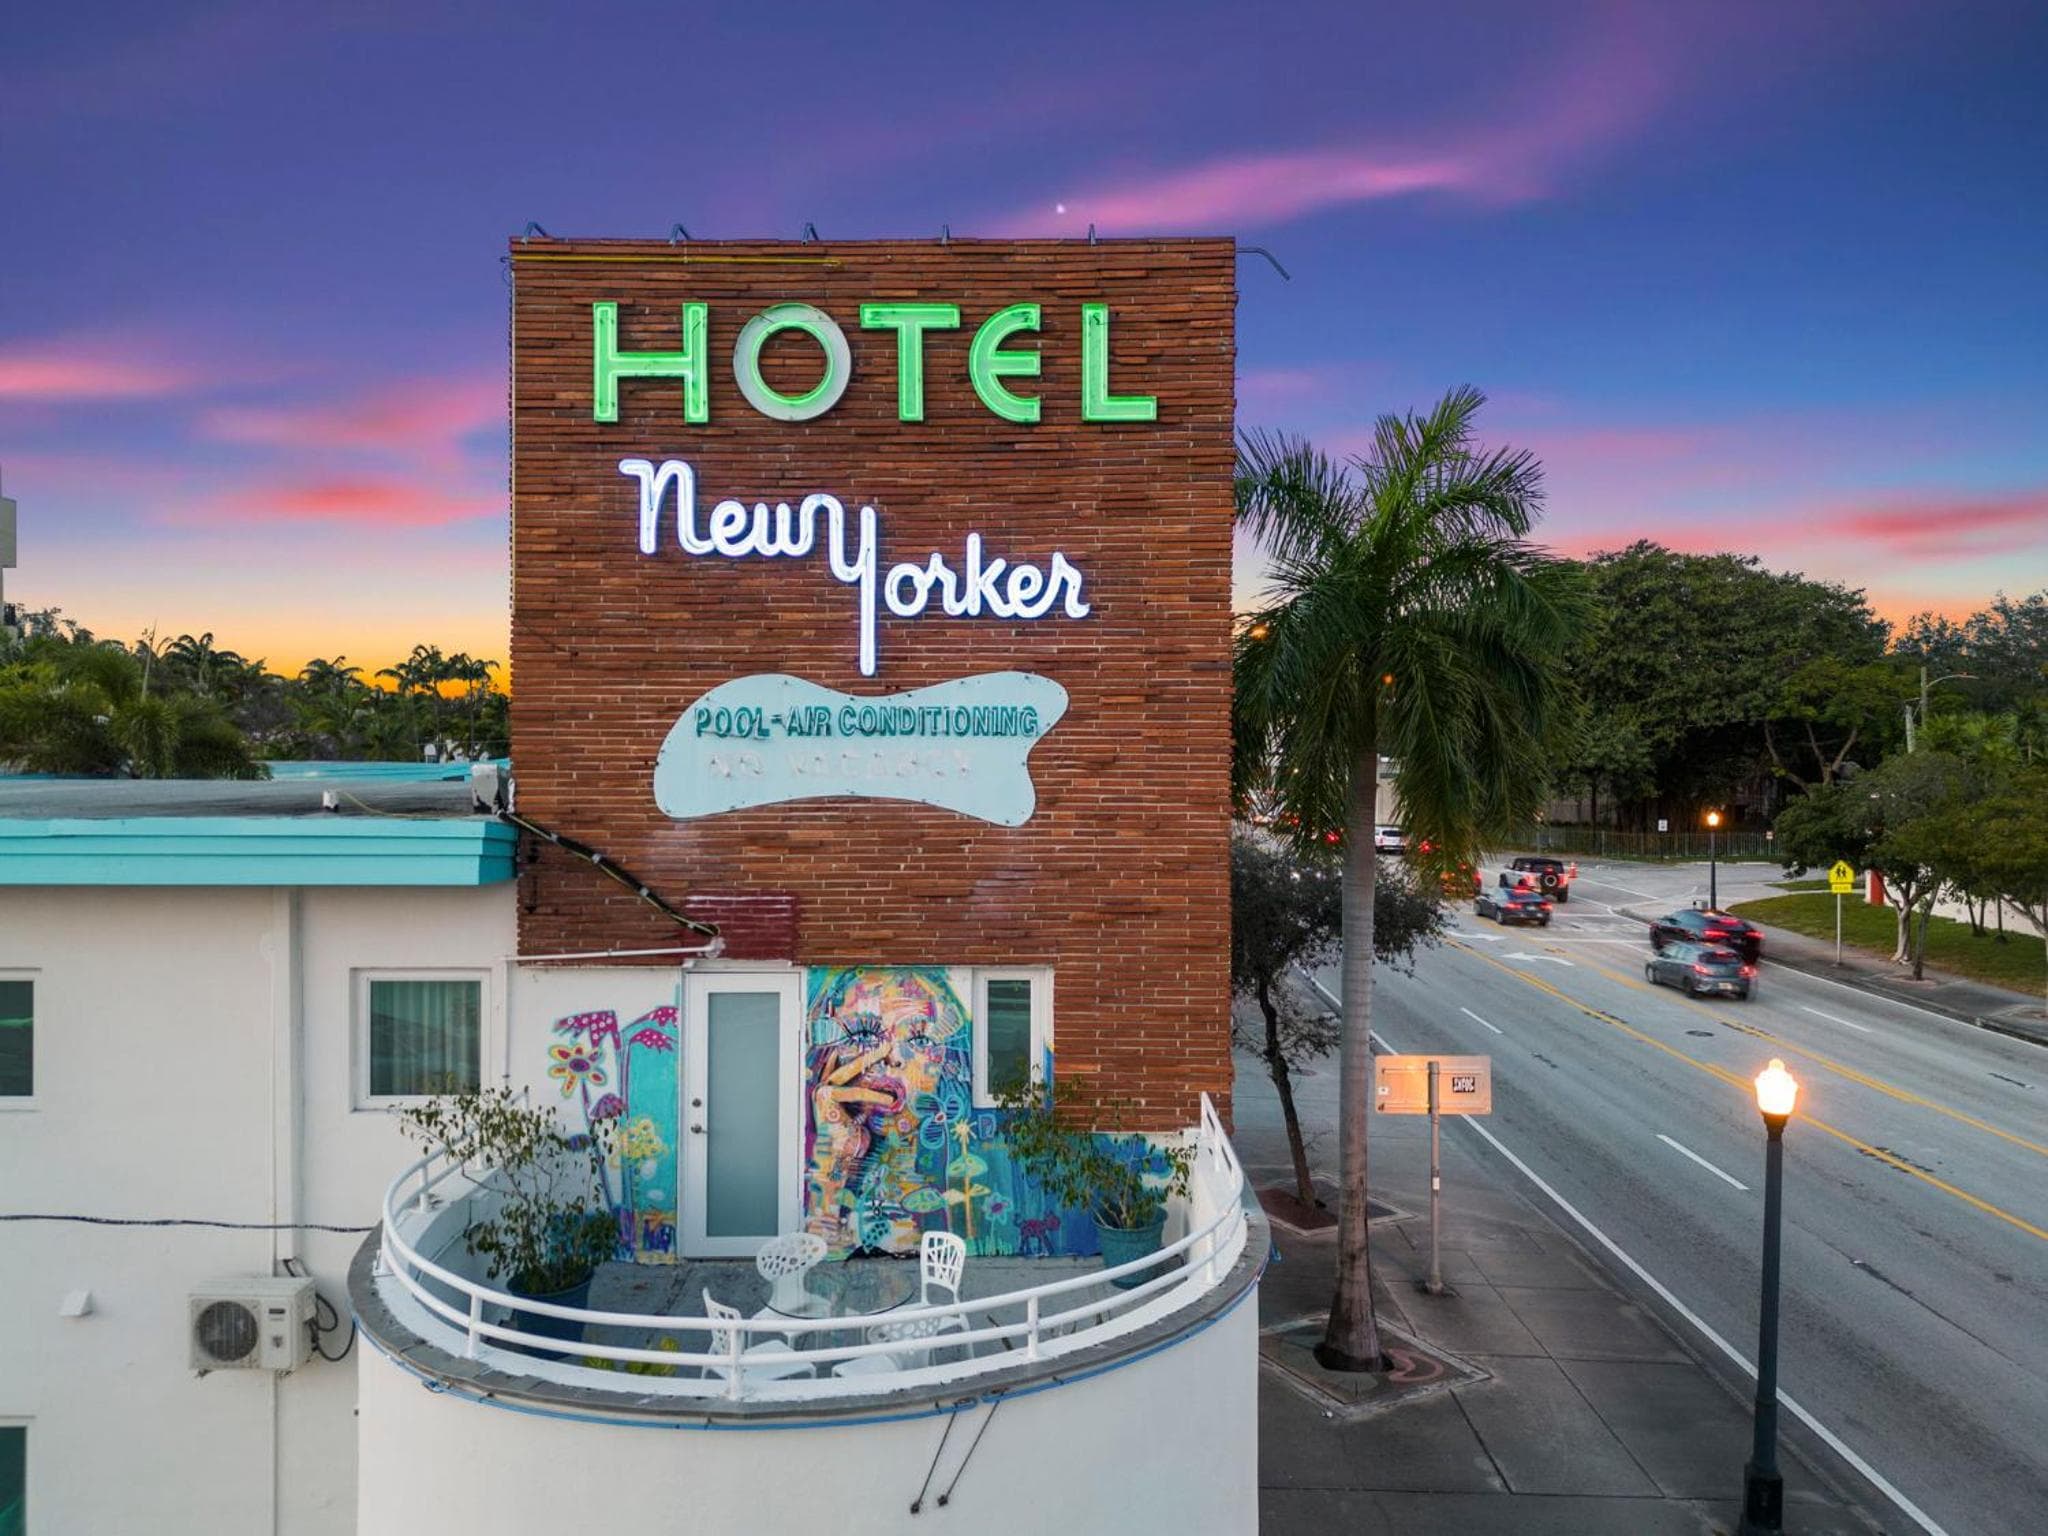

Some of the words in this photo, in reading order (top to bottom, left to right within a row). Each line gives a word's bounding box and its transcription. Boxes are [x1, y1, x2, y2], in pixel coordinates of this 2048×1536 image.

[593, 303, 1157, 423] HOTEL
[618, 459, 809, 557] New
[801, 493, 1091, 677] Yorker
[838, 705, 1039, 738] CONDITIONING
